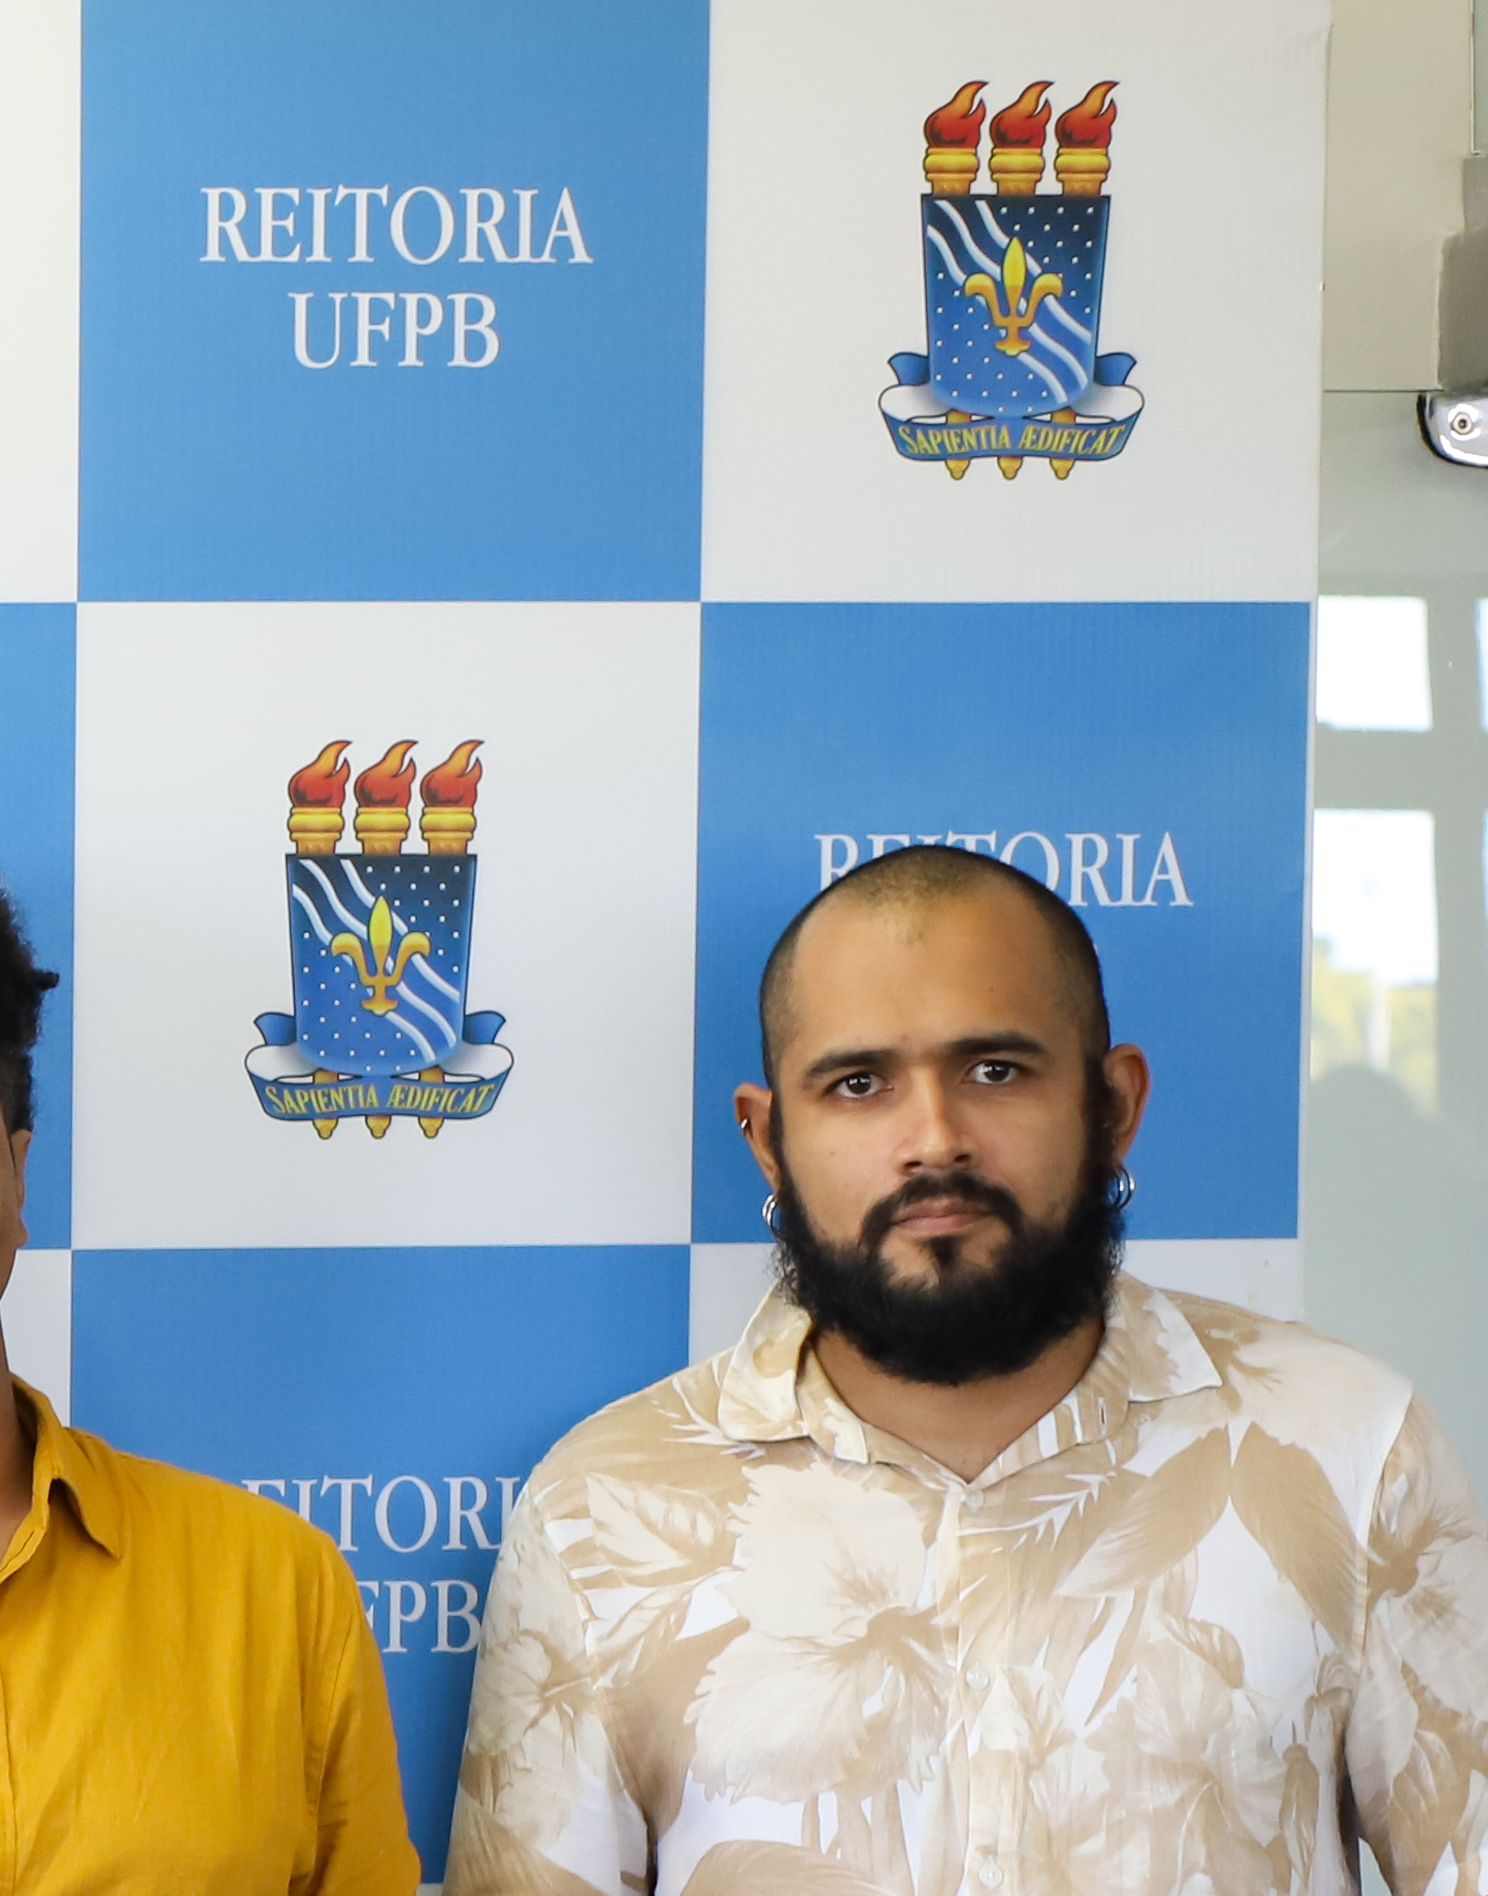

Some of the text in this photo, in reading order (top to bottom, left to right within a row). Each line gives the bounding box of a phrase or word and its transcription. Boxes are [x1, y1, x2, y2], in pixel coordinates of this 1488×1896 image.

[201, 185, 592, 264] REITORIA
[289, 292, 499, 368] UFPB
[898, 425, 1011, 455] SAPIENTIA
[265, 1083, 380, 1114] SAPIENTIA
